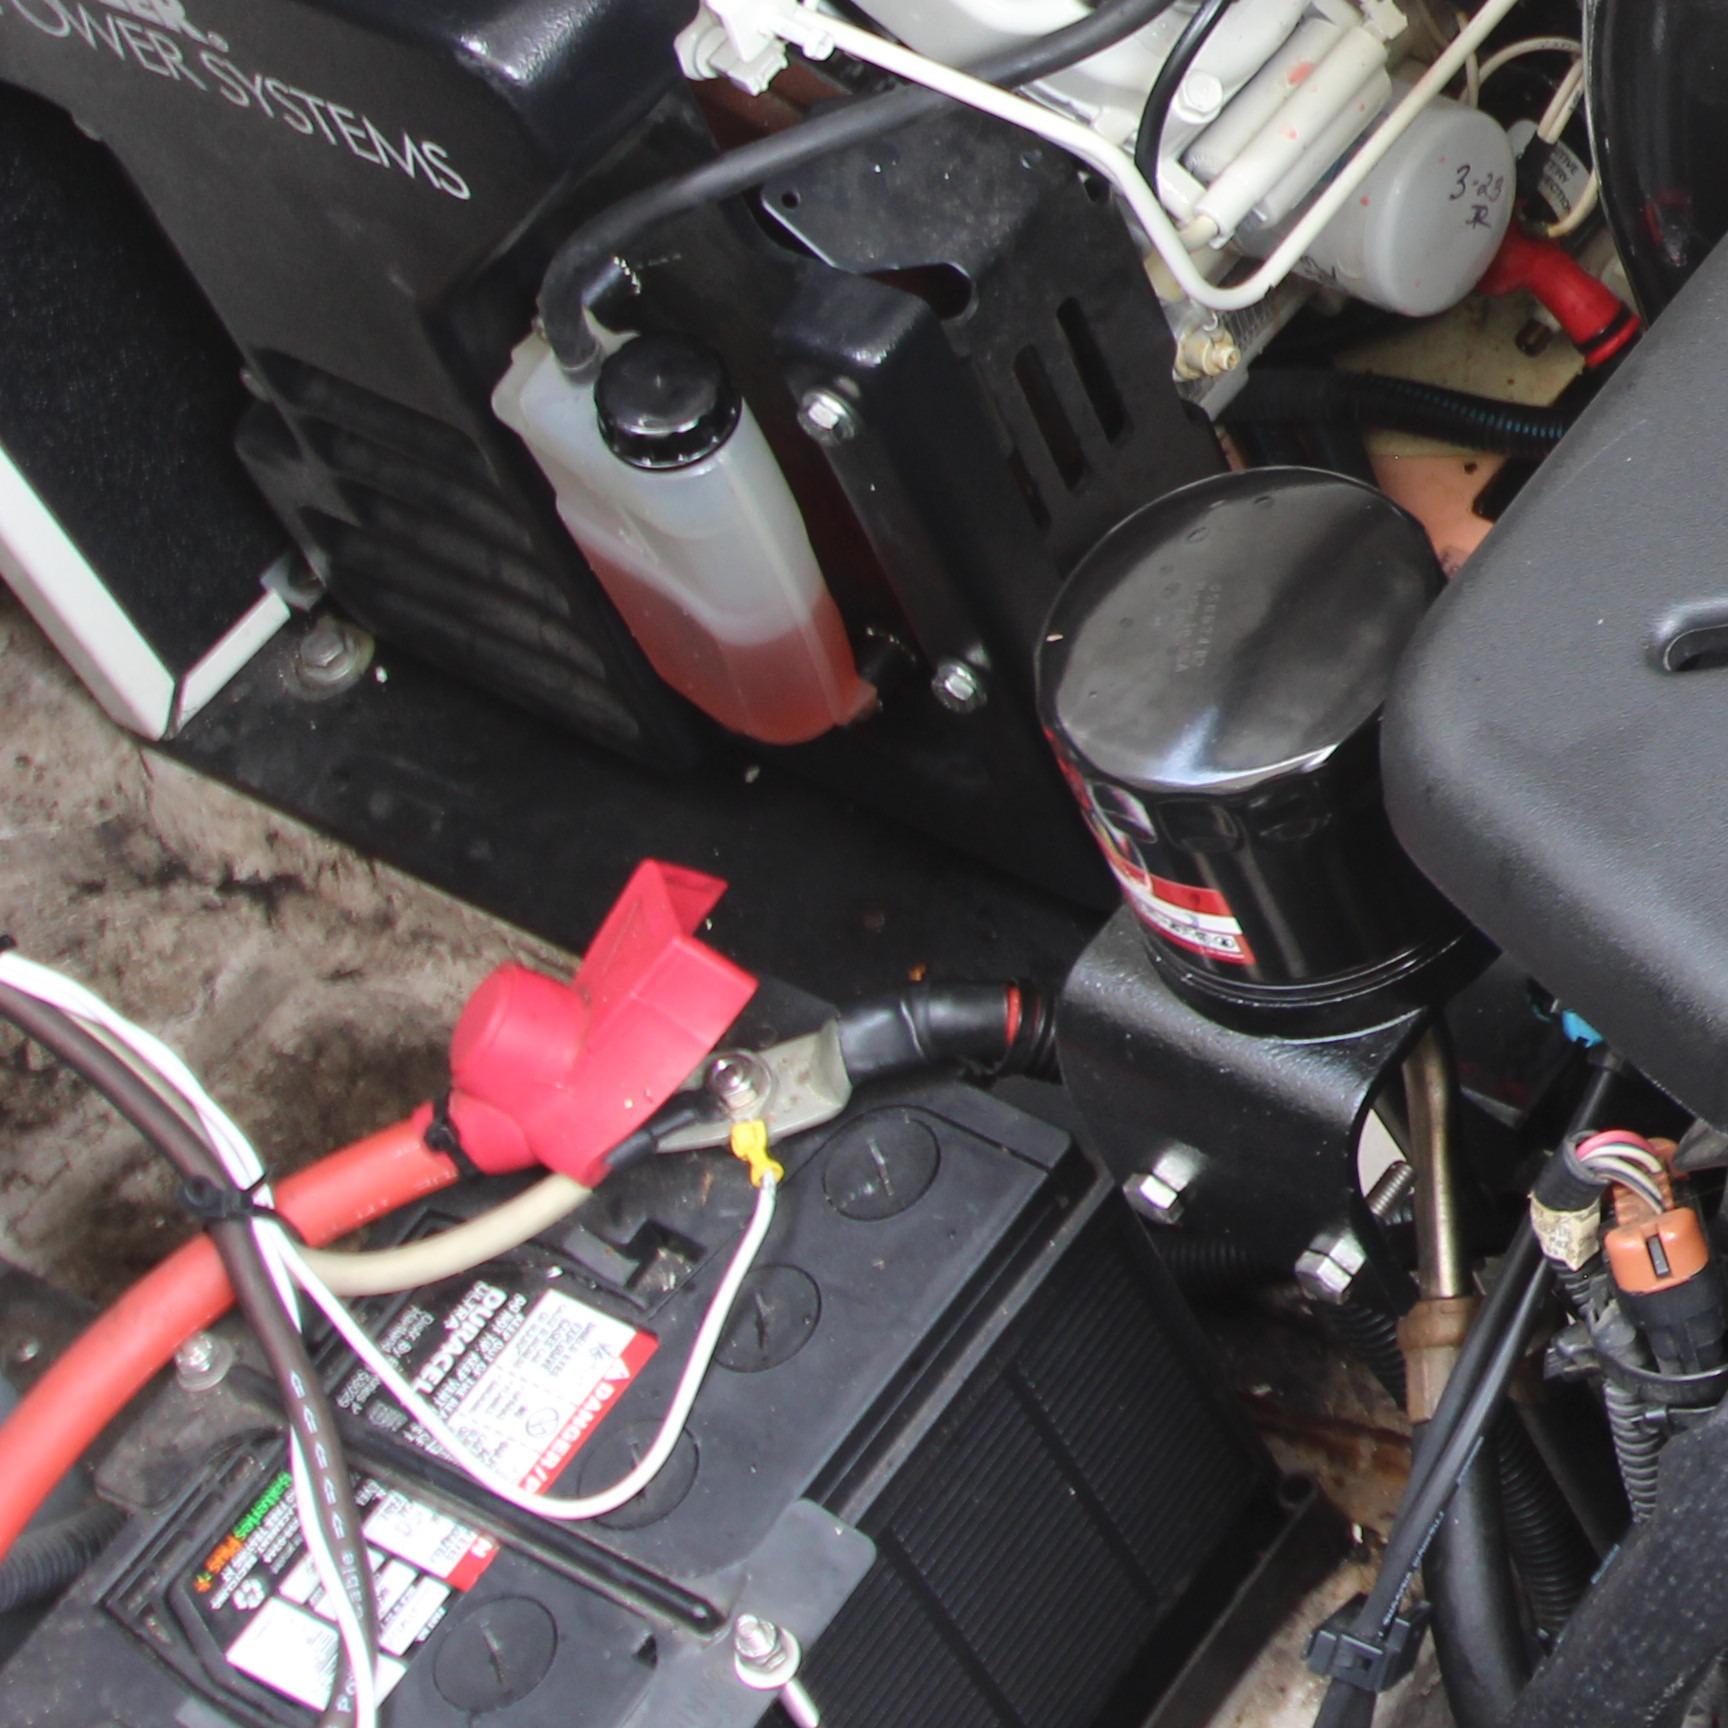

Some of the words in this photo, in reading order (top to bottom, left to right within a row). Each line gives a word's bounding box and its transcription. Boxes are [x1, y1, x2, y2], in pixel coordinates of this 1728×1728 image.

[200, 51, 471, 200] SYSTEMS
[406, 1283, 509, 1400] DURACEL
[440, 1278, 491, 1333] ULTRA
[230, 1470, 295, 1542] Batteries
[201, 1534, 244, 1576] Plus
